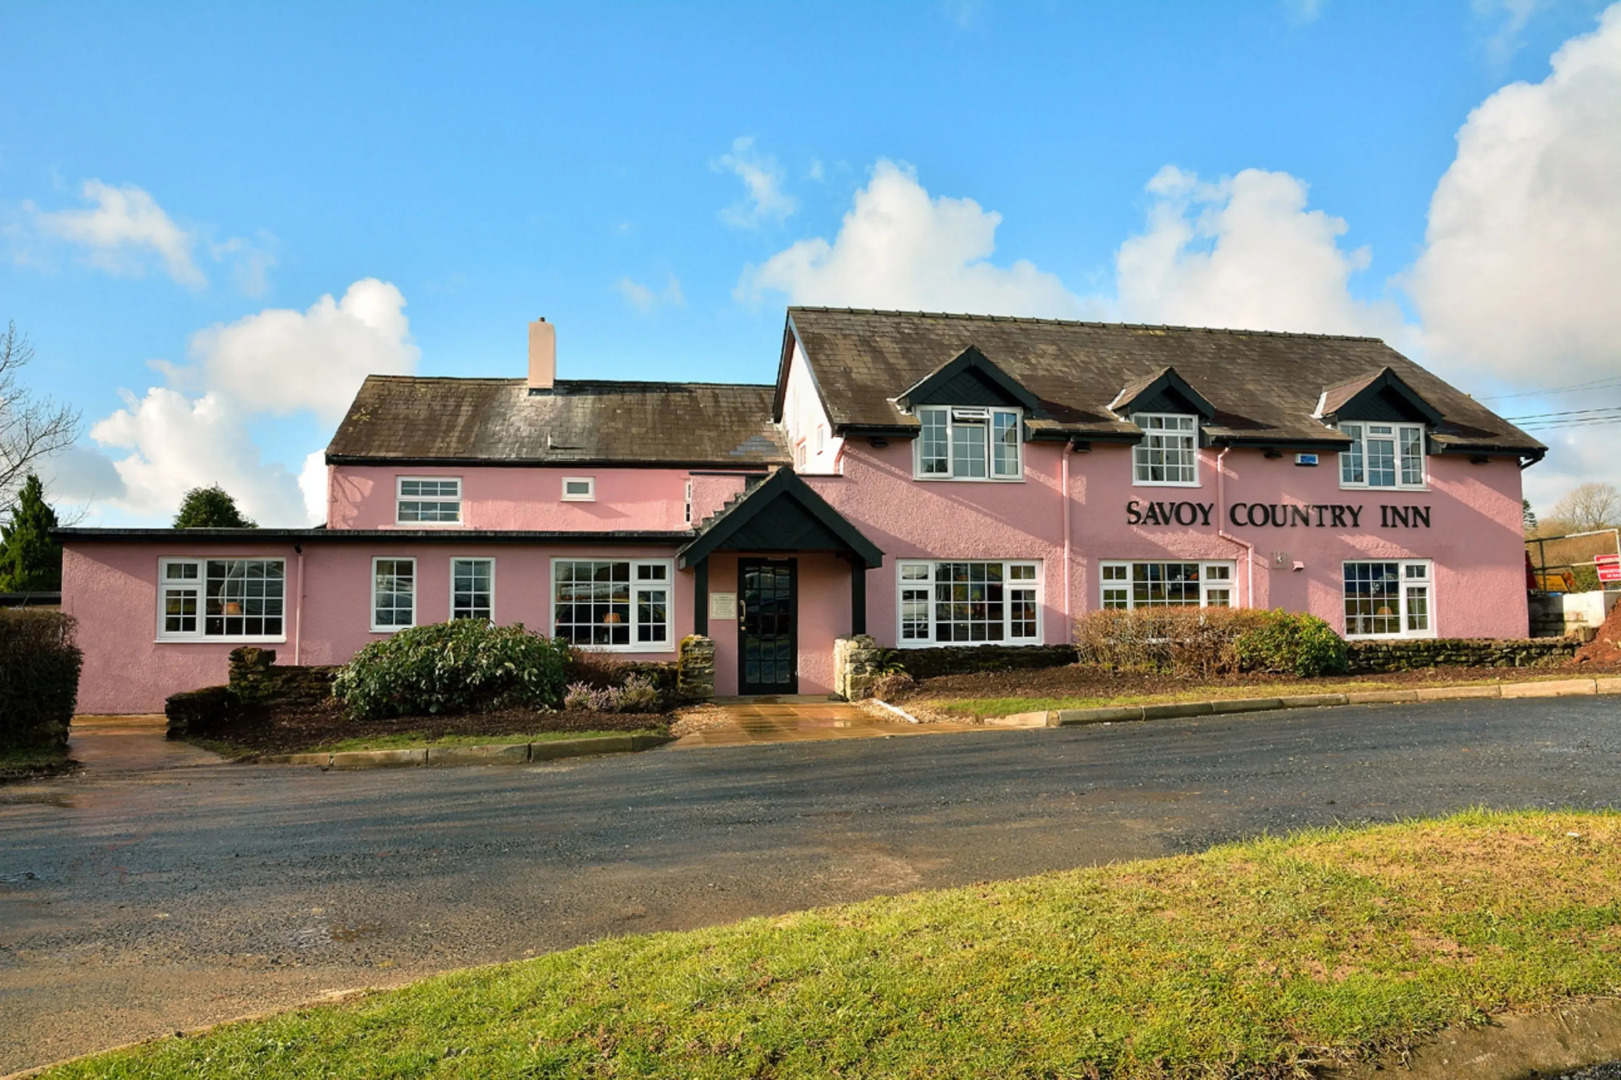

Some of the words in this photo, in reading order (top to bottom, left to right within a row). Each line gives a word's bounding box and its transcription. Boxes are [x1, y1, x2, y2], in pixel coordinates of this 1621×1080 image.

[1126, 501, 1214, 525] SAVOY
[1229, 502, 1363, 527] COUNTRY
[1379, 504, 1431, 528] INN
